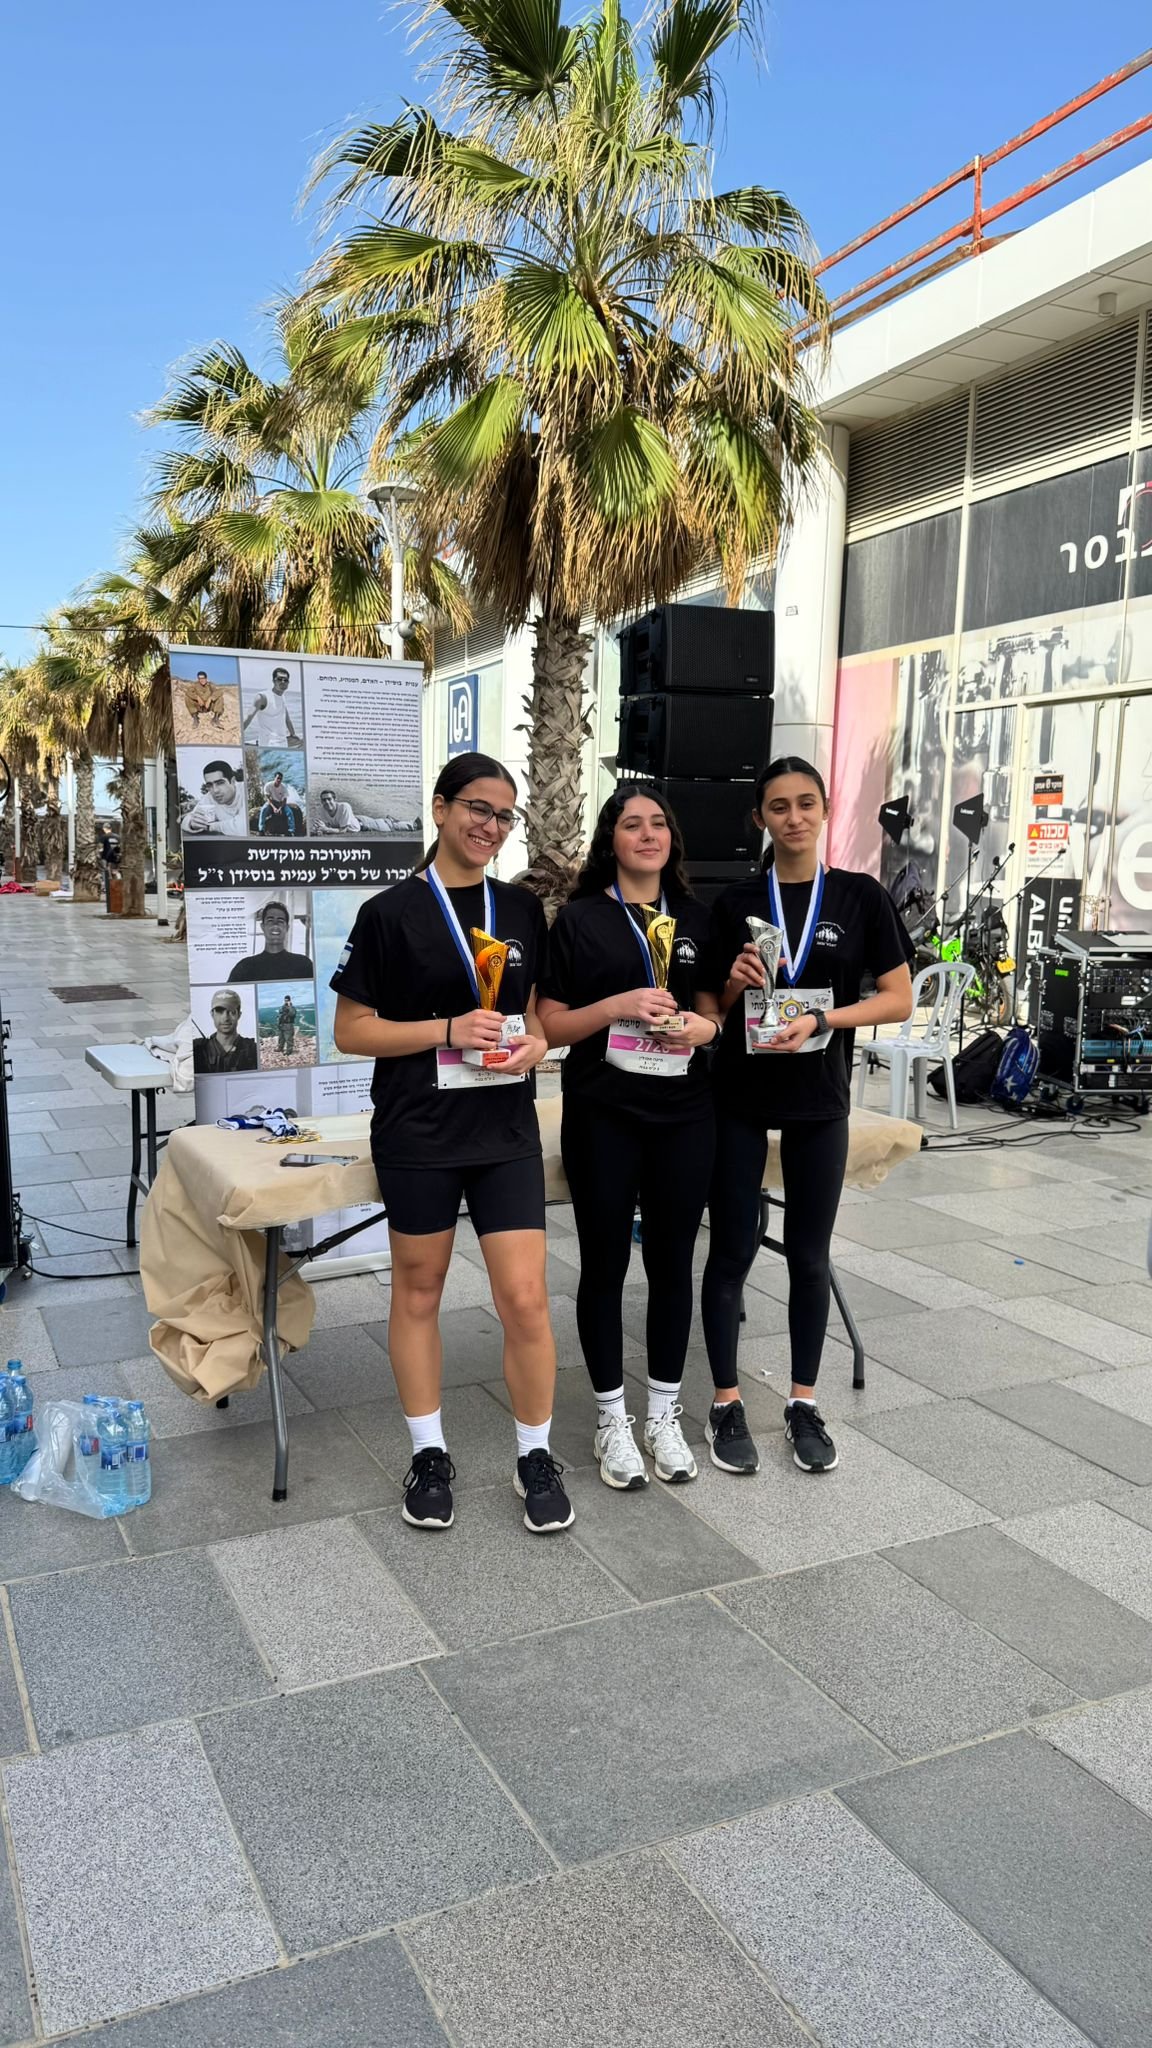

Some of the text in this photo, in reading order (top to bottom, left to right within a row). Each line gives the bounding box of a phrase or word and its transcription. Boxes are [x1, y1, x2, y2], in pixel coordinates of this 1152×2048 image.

[1060, 528, 1152, 573] בסר
[1039, 825, 1065, 838] סכנה
[247, 847, 371, 863] התערוכה מוקדשת
[229, 869, 275, 885] בוסידן
[280, 869, 317, 883] עמית
[361, 867, 380, 880] של
[385, 866, 415, 881] זכרו
[617, 1018, 641, 1029] סיימתי
